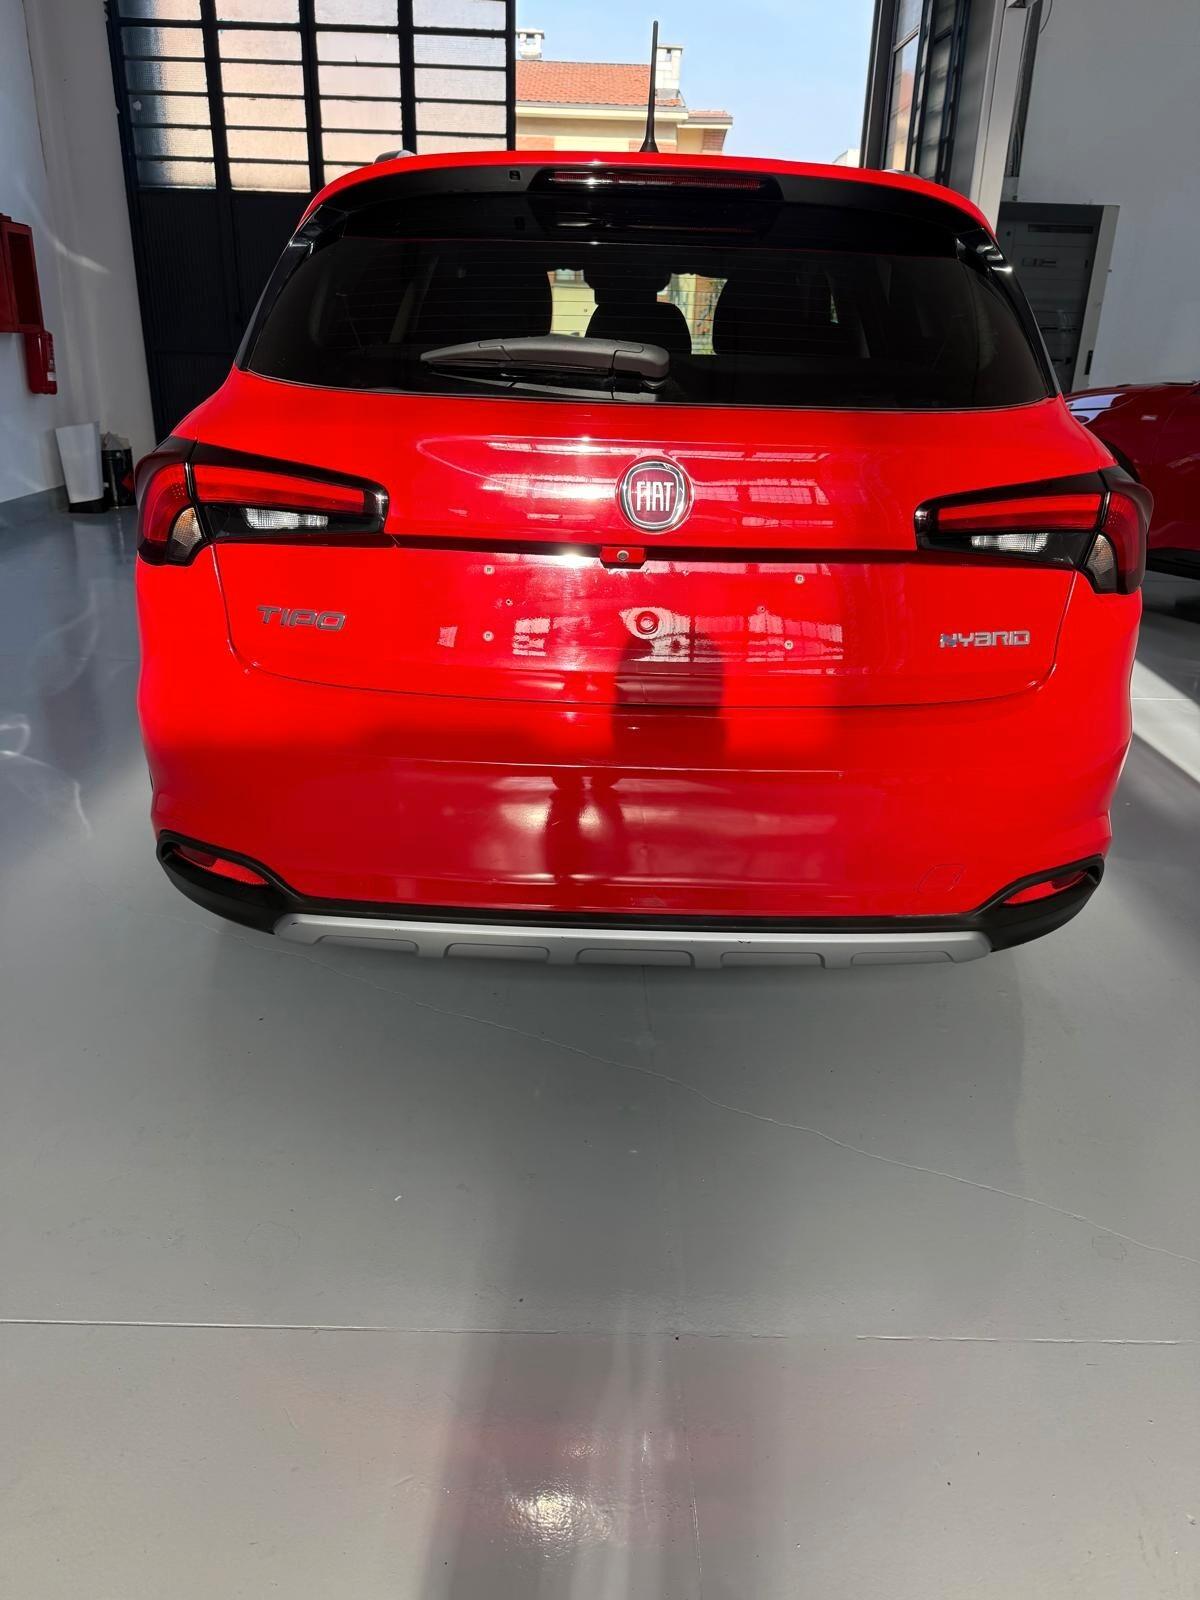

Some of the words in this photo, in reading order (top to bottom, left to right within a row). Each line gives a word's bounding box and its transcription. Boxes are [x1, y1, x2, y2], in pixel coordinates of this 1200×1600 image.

[636, 481, 674, 511] FIAT
[257, 605, 346, 631] TIPO
[940, 630, 1030, 648] HYBRID
